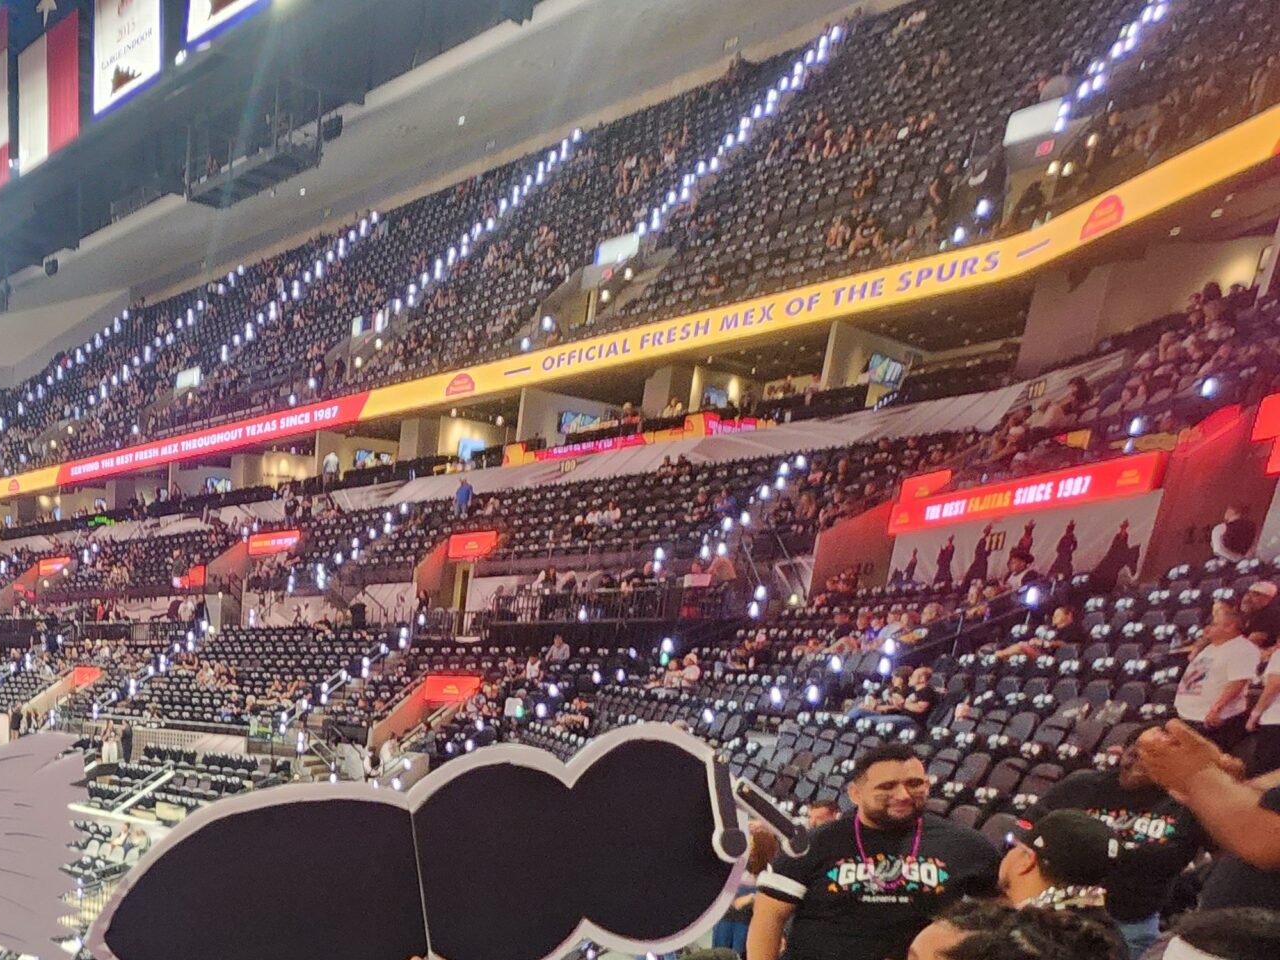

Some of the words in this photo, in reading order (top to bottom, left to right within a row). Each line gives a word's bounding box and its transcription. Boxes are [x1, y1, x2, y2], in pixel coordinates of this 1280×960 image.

[541, 339, 632, 372] OFFICIAL
[640, 319, 710, 352] FRESH
[719, 303, 775, 332] MEX
[785, 292, 822, 316] OF
[832, 277, 885, 307] THE
[896, 250, 1000, 293] SPURS
[101, 457, 115, 469] THE
[116, 453, 133, 467] BEST
[134, 448, 158, 463] FRESH
[160, 443, 179, 458] MEX
[181, 428, 243, 452] THROUGHOUT
[245, 419, 277, 438] TEXAS
[280, 413, 311, 431] SINCE
[313, 405, 339, 422] 1987
[925, 504, 942, 520] THE
[942, 500, 967, 518] BEST
[967, 491, 1012, 513] FAJITAS
[1013, 482, 1054, 505] SINCE
[1057, 475, 1092, 498] 1987
[902, 862, 938, 887] GO
